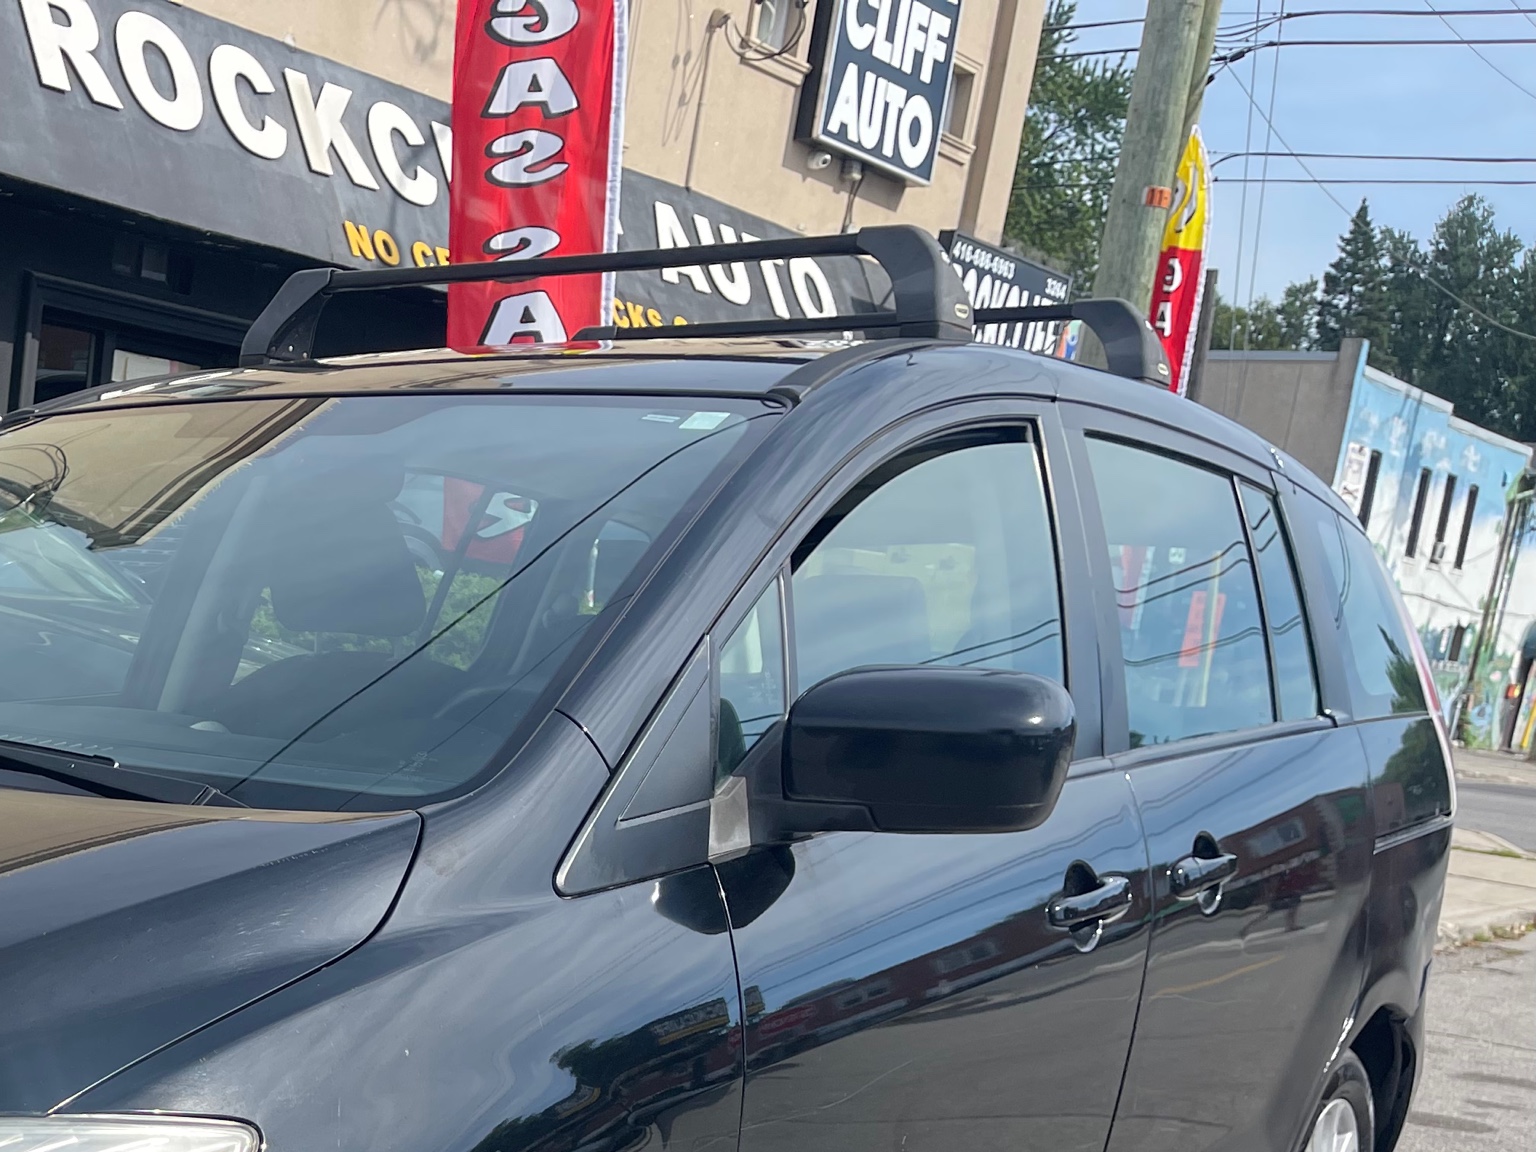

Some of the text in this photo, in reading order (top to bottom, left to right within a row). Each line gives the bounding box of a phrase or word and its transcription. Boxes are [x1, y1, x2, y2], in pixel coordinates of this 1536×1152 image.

[846, 0, 951, 84] CLIFF
[827, 62, 933, 168] AUTO
[343, 220, 400, 266] NO
[654, 201, 838, 320] AUTO
